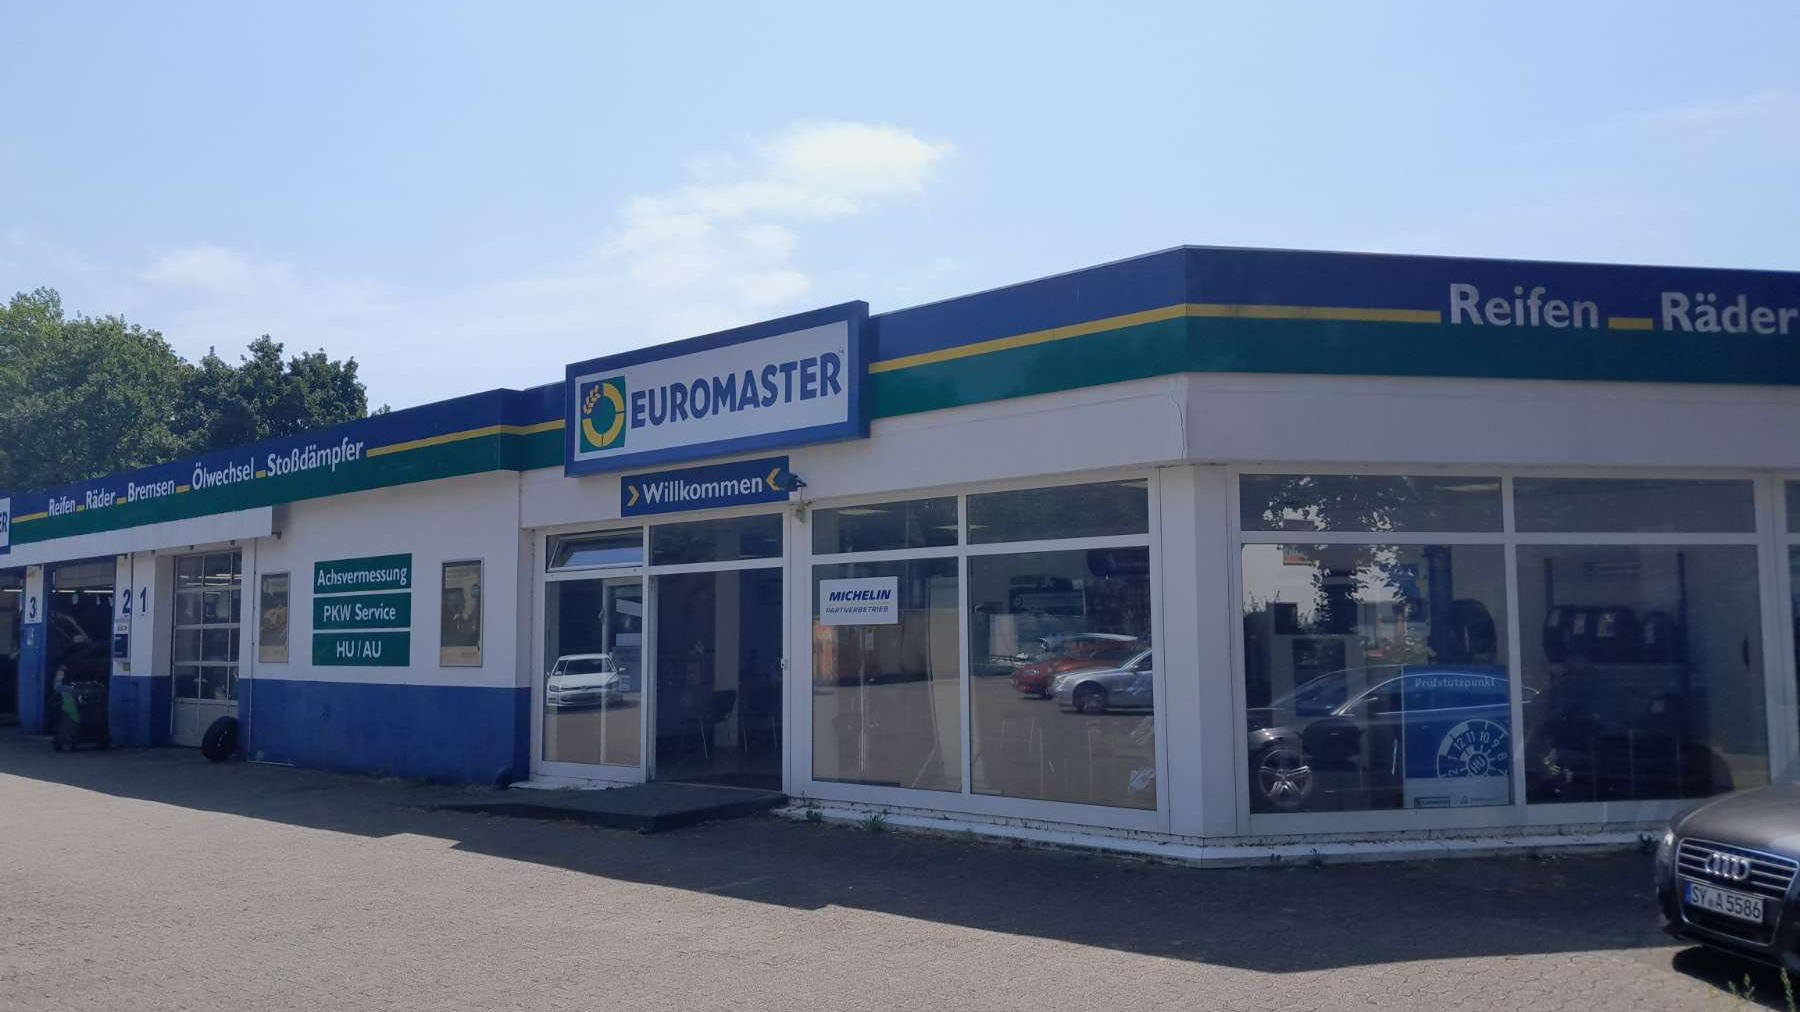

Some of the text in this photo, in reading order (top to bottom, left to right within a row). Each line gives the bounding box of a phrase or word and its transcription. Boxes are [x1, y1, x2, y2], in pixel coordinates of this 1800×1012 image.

[1450, 283, 1799, 335] Reifen Räder
[631, 352, 842, 430] EUROMASTER
[48, 436, 364, 516] Reifen Räder Bremsen Ölwechsel Stoßdämpfer
[643, 477, 763, 504] Willkommen
[317, 568, 407, 586] Achsvermessung
[30, 596, 36, 618] 3
[122, 589, 131, 614] 2
[140, 586, 147, 613] 1
[829, 589, 892, 602] MICHELIN
[323, 602, 397, 622] PKW Service
[1726, 894, 1761, 918] 5586
